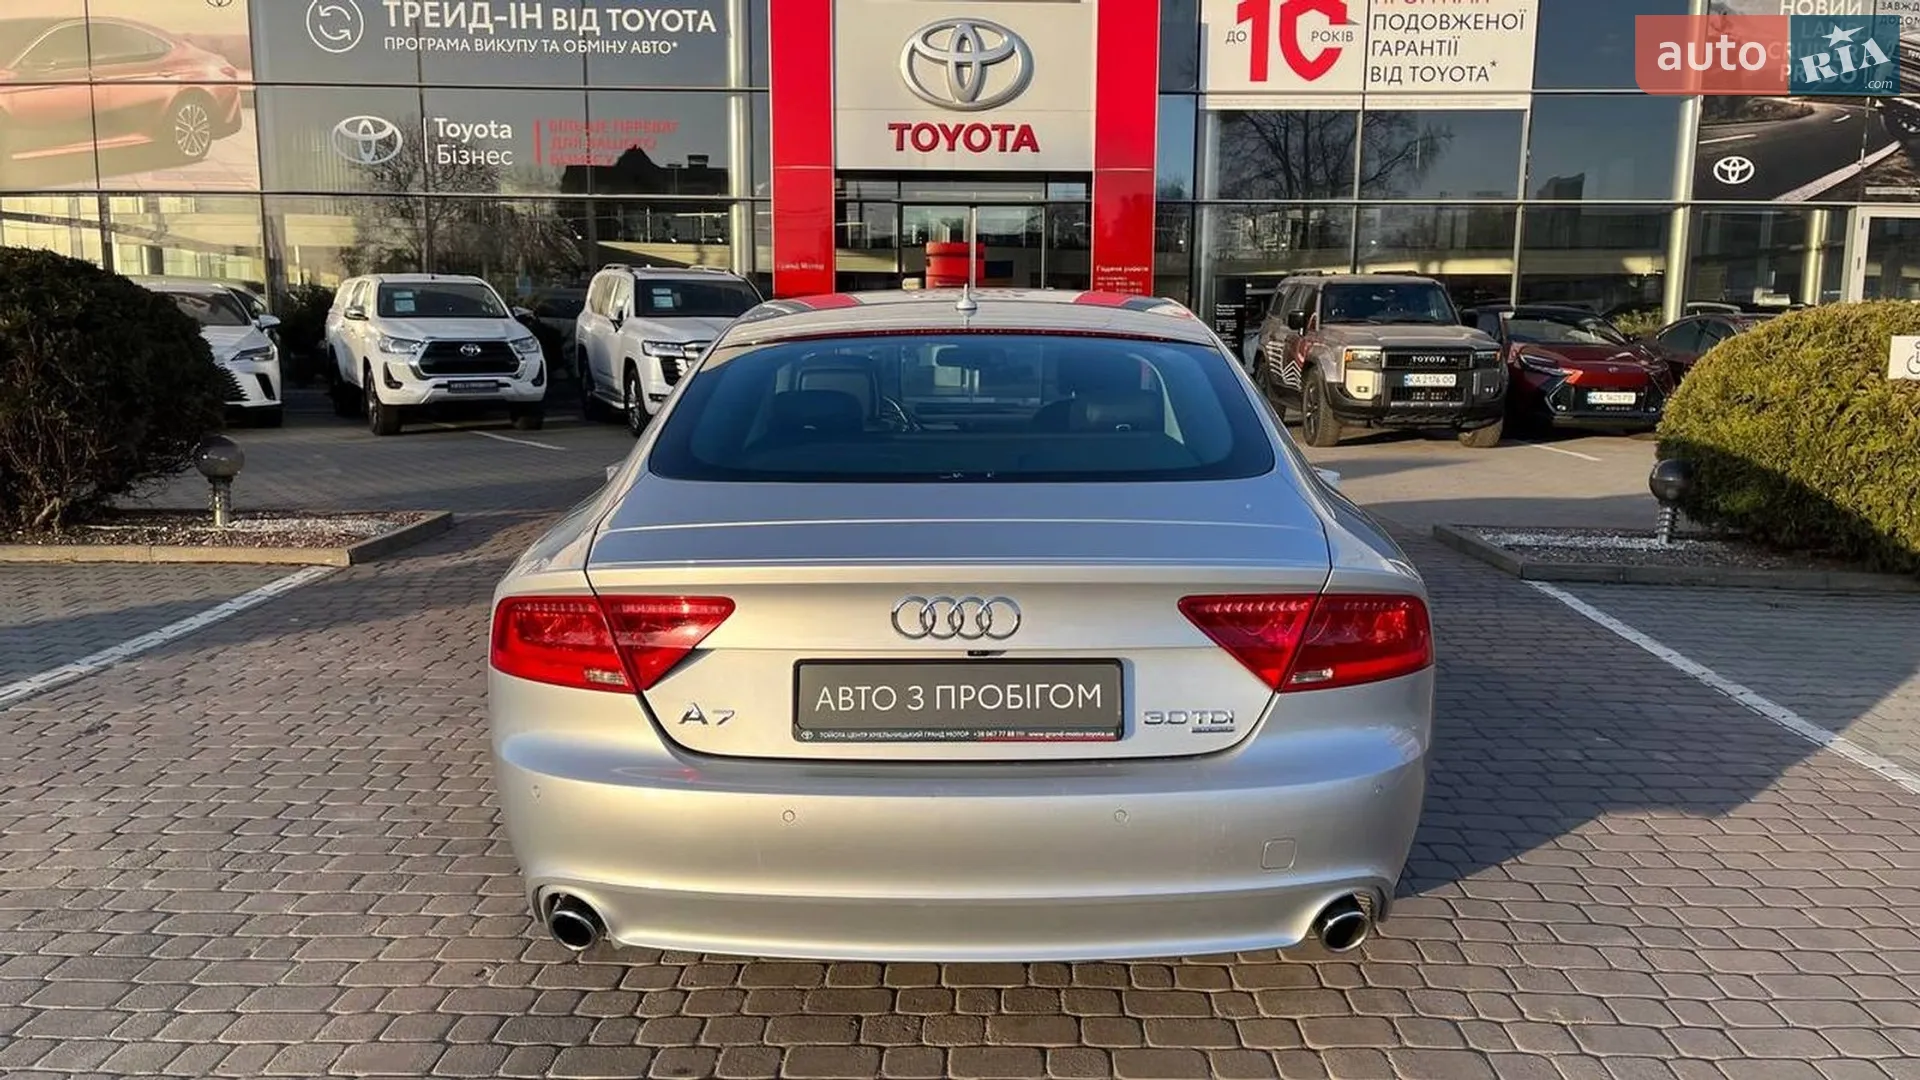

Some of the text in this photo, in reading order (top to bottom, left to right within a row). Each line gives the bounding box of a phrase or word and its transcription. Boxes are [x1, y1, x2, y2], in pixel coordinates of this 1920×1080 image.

[552, 8, 601, 36] ВІД
[606, 9, 717, 33] TOYOTA
[1373, 9, 1527, 34] ПОДОВЖЕНОЇ
[384, 37, 470, 51] ПРОГРАМА
[474, 38, 538, 53] ВИКУПУ
[541, 39, 560, 52] ТА
[563, 39, 628, 54] ОБМІНУ
[1225, 30, 1248, 44] ДО
[1311, 31, 1354, 42] РОКІВ
[1371, 36, 1461, 57] ГАРАНТІЇ
[1370, 66, 1403, 85] ВІД
[434, 117, 513, 143] Toyota
[888, 122, 1040, 153] TOYOTA
[437, 144, 514, 165] Бізнес
[1411, 355, 1446, 363] TOYOTA
[815, 683, 1101, 711] АВТО З ПРОБІГОМ
[678, 702, 735, 726] A7
